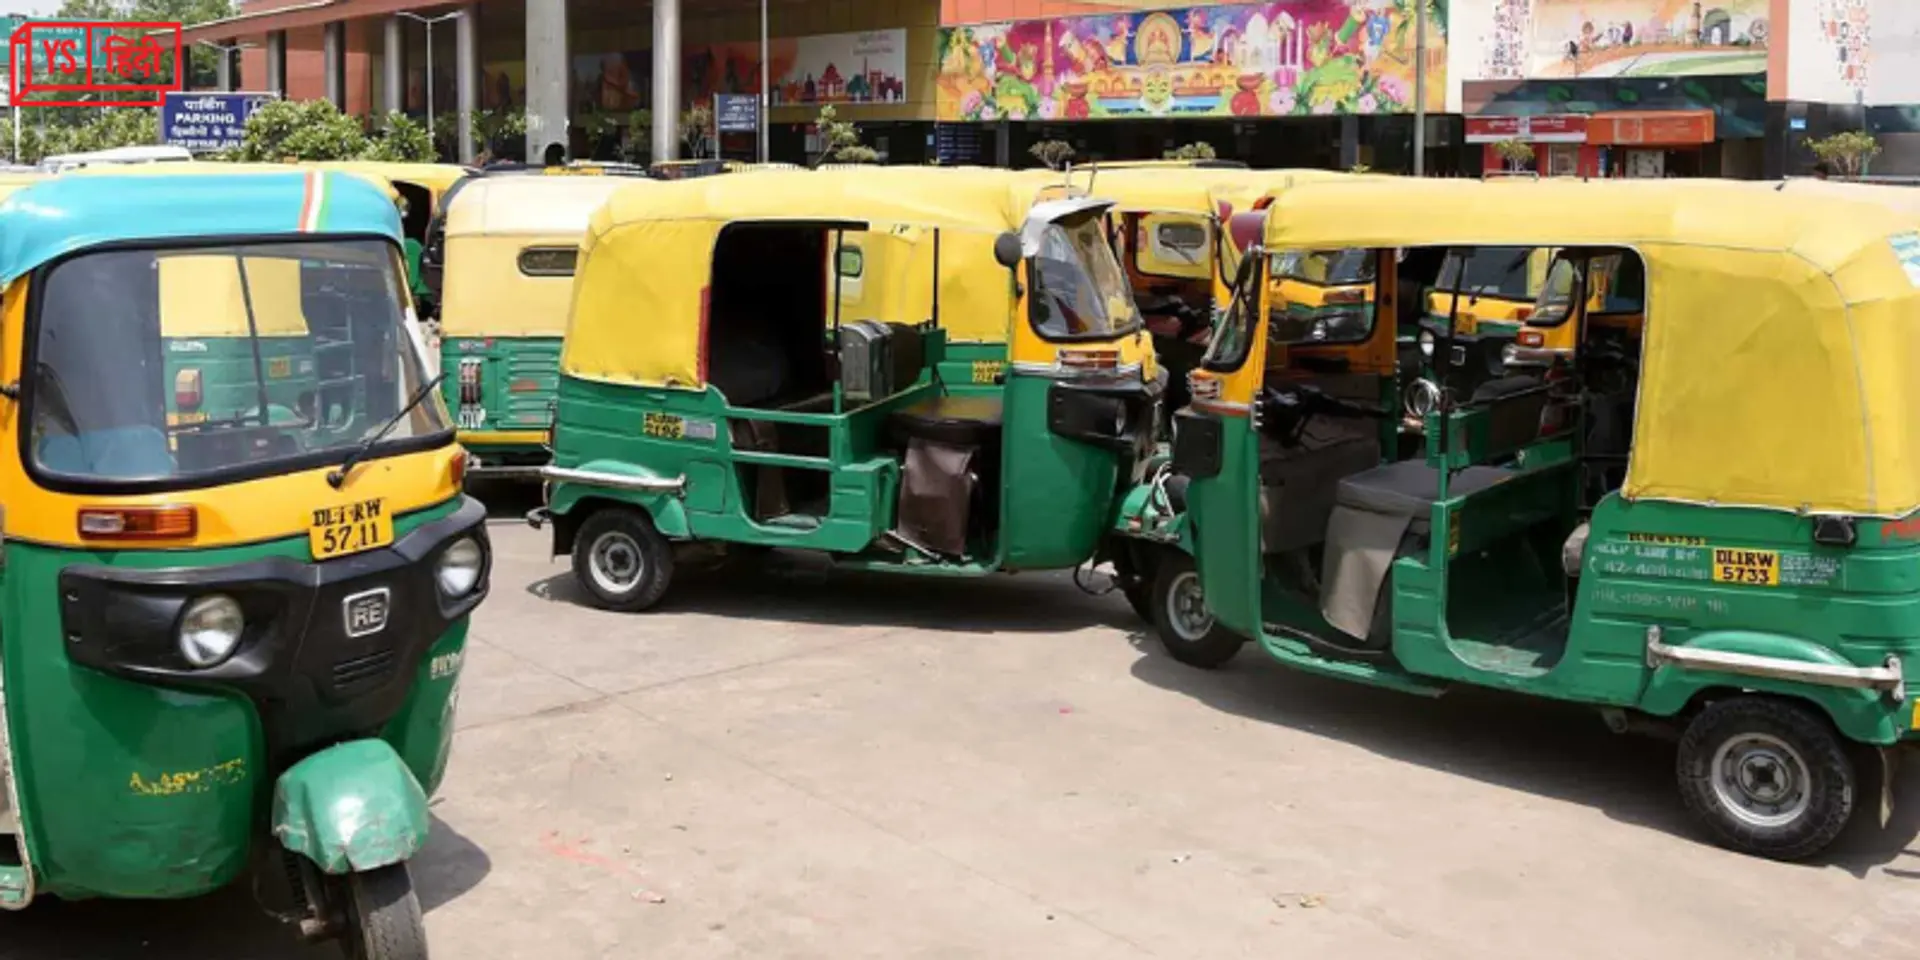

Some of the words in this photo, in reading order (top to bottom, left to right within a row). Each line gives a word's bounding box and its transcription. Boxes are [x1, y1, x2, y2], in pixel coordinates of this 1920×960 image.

[175, 112, 236, 124] PARKING
[1716, 549, 1775, 567] DL1RW
[1722, 566, 1770, 583] 5733
[353, 601, 383, 628] RE
